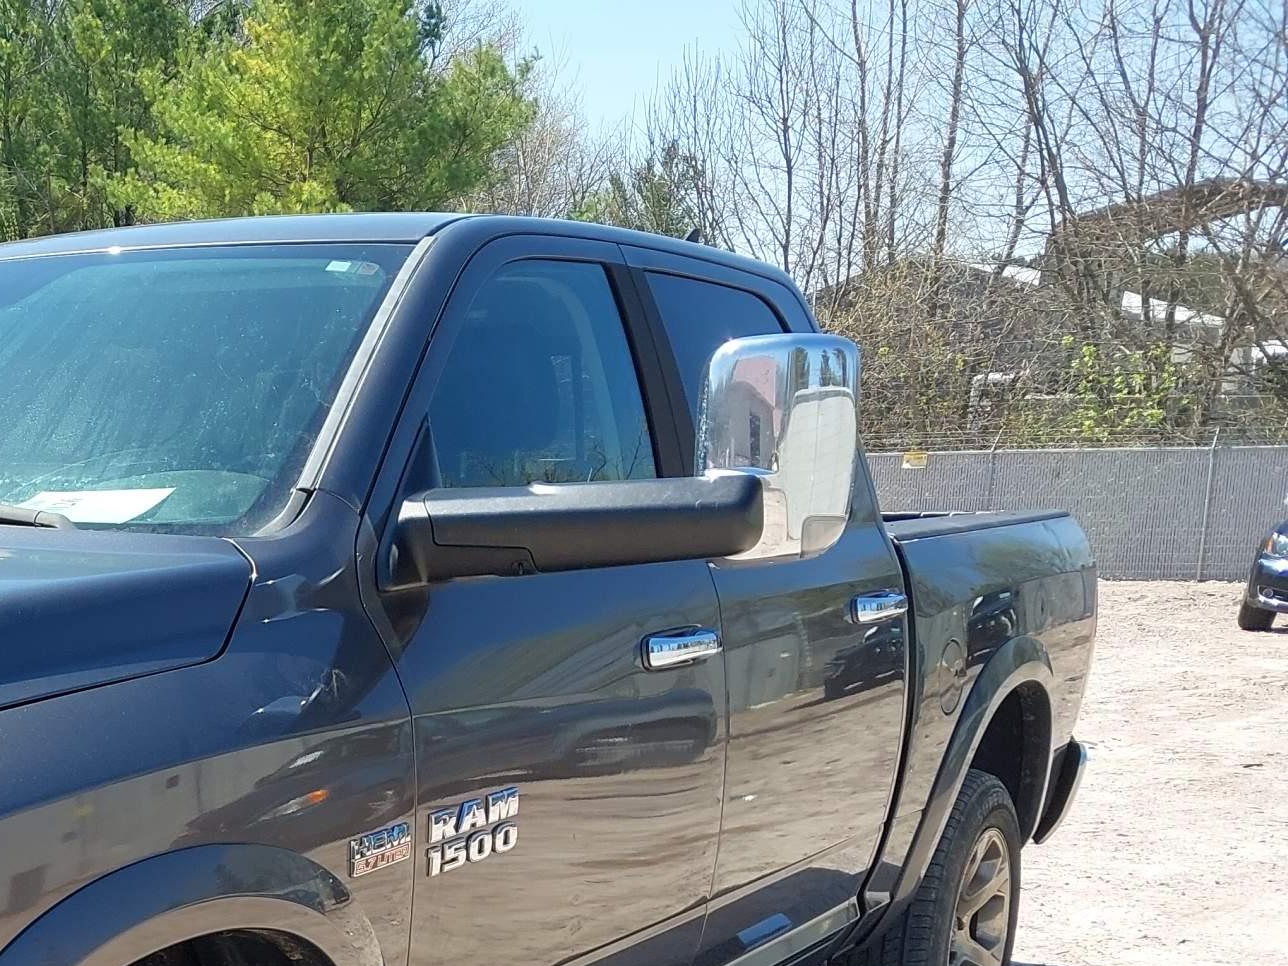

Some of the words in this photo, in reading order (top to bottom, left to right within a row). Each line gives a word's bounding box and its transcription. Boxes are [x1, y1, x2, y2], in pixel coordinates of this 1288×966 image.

[350, 822, 411, 859] HEMI
[428, 787, 520, 843] RAM
[426, 821, 518, 876] 1500
